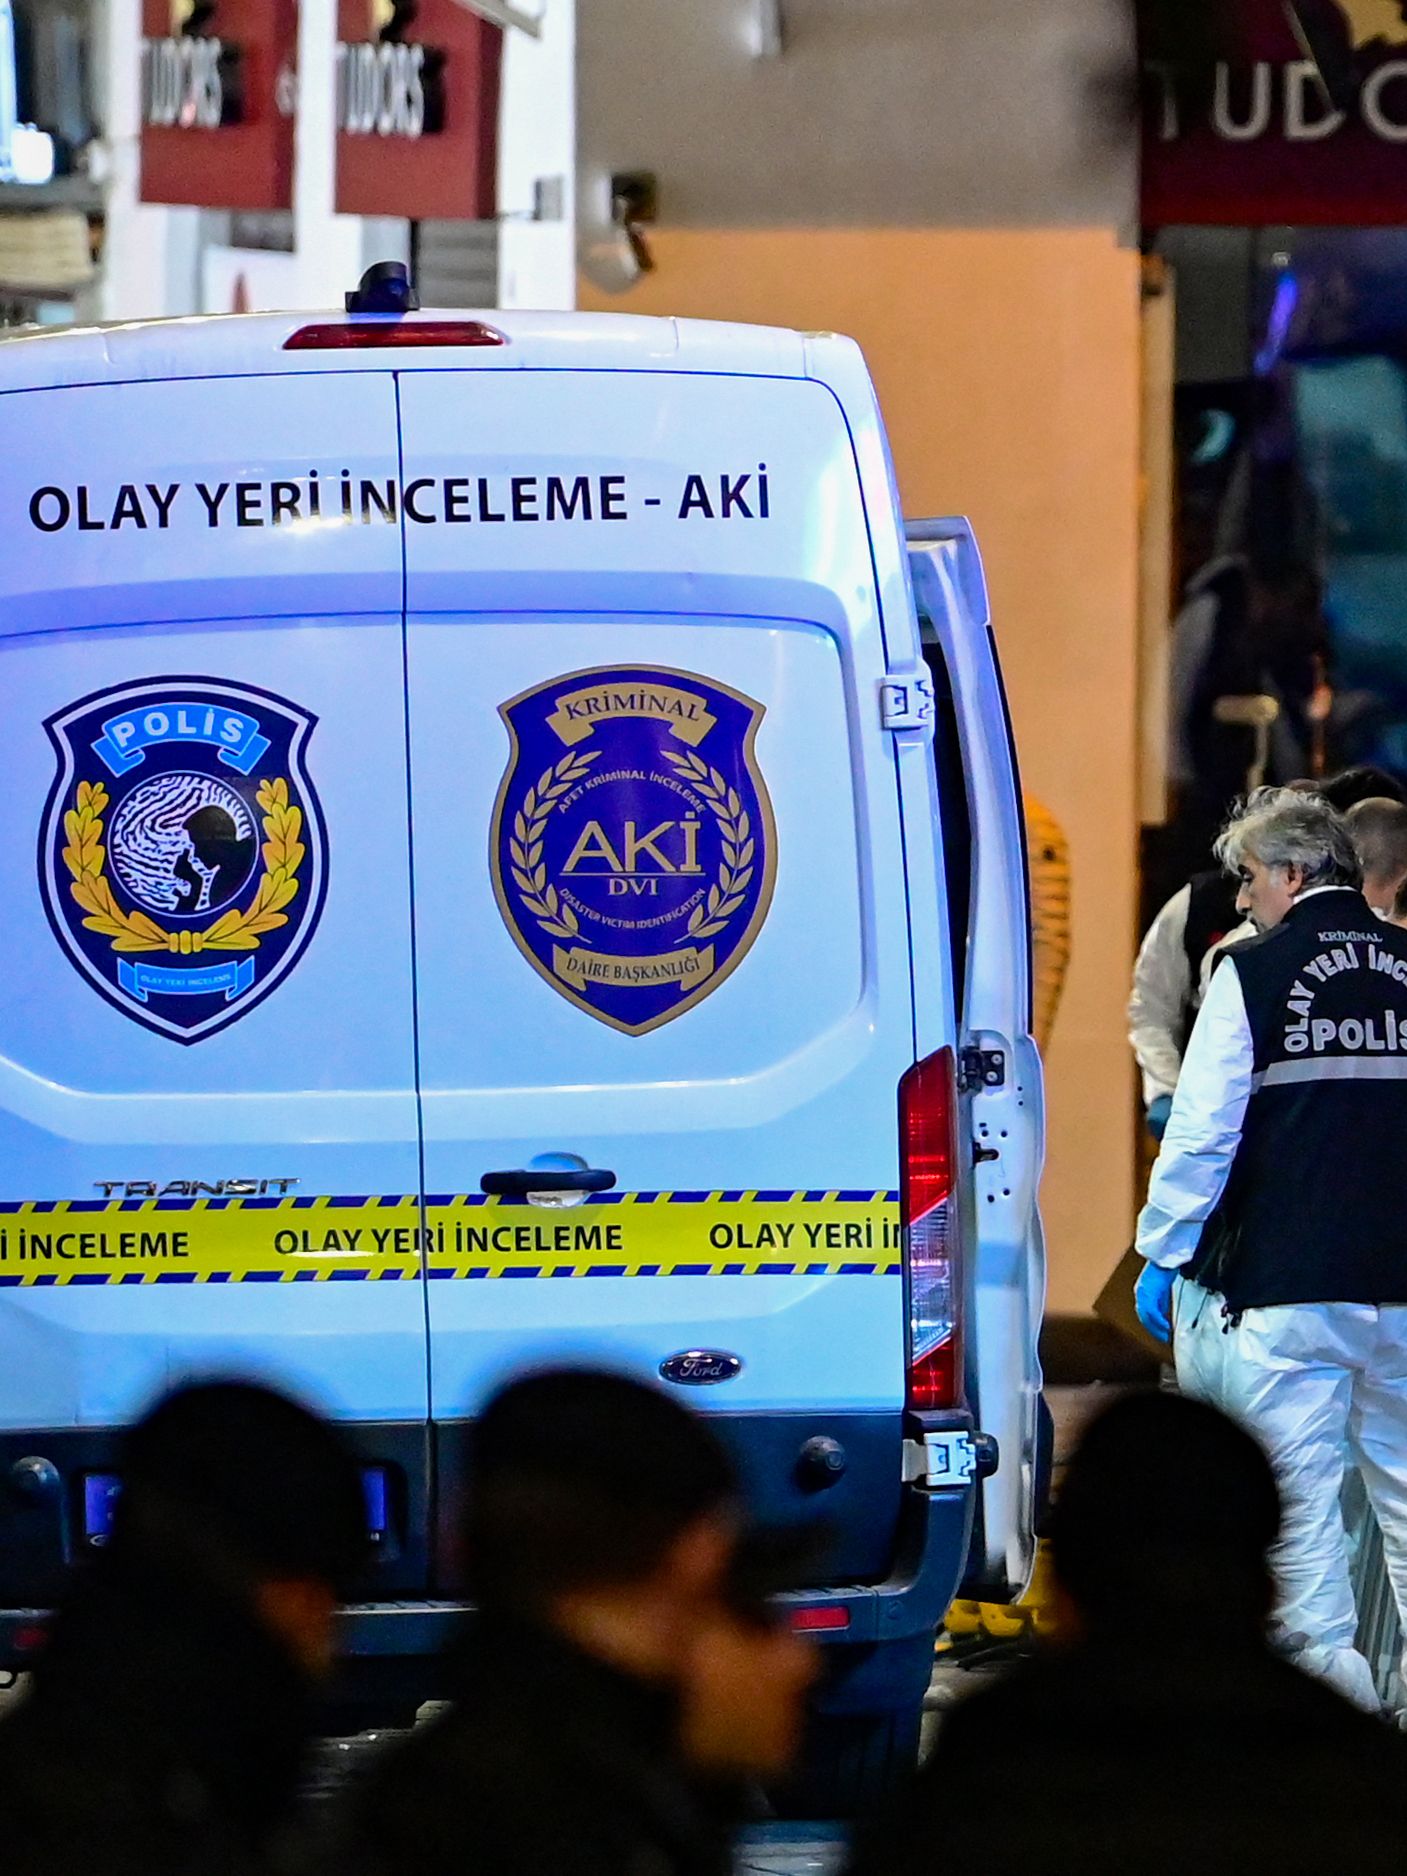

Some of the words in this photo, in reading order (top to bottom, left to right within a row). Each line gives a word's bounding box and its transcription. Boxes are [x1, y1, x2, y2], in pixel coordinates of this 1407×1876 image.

[29, 483, 181, 533] OLAY
[195, 469, 320, 528] YERİ
[341, 468, 628, 526] İNCELEME
[677, 462, 770, 519] AKİ
[565, 689, 700, 722] KRİMİNAL
[112, 708, 244, 748] POLİS
[558, 786, 584, 814] AFET
[585, 770, 646, 790] KRİMİNAL
[649, 770, 707, 813] İNCELEME
[562, 811, 702, 873] AKİ
[608, 878, 659, 896] DVI
[559, 888, 601, 922] DISASTER
[601, 916, 635, 929] VICTIM
[636, 888, 707, 929] IDENTIFICATION
[566, 957, 609, 979] DAİRE
[613, 956, 701, 983] BAŞKANLIĞI
[1284, 979, 1316, 1053] OLAY
[1302, 942, 1360, 982] YERİ
[94, 1178, 301, 1198] TRANSIT
[19, 1228, 189, 1260] İNCELEME
[274, 1228, 363, 1255] OLAY
[371, 1222, 444, 1254] YERİ
[455, 1222, 623, 1252] İNCELEME
[709, 1223, 795, 1249] OLAY
[803, 1217, 873, 1248] YERİ
[680, 1358, 723, 1377] Ford
